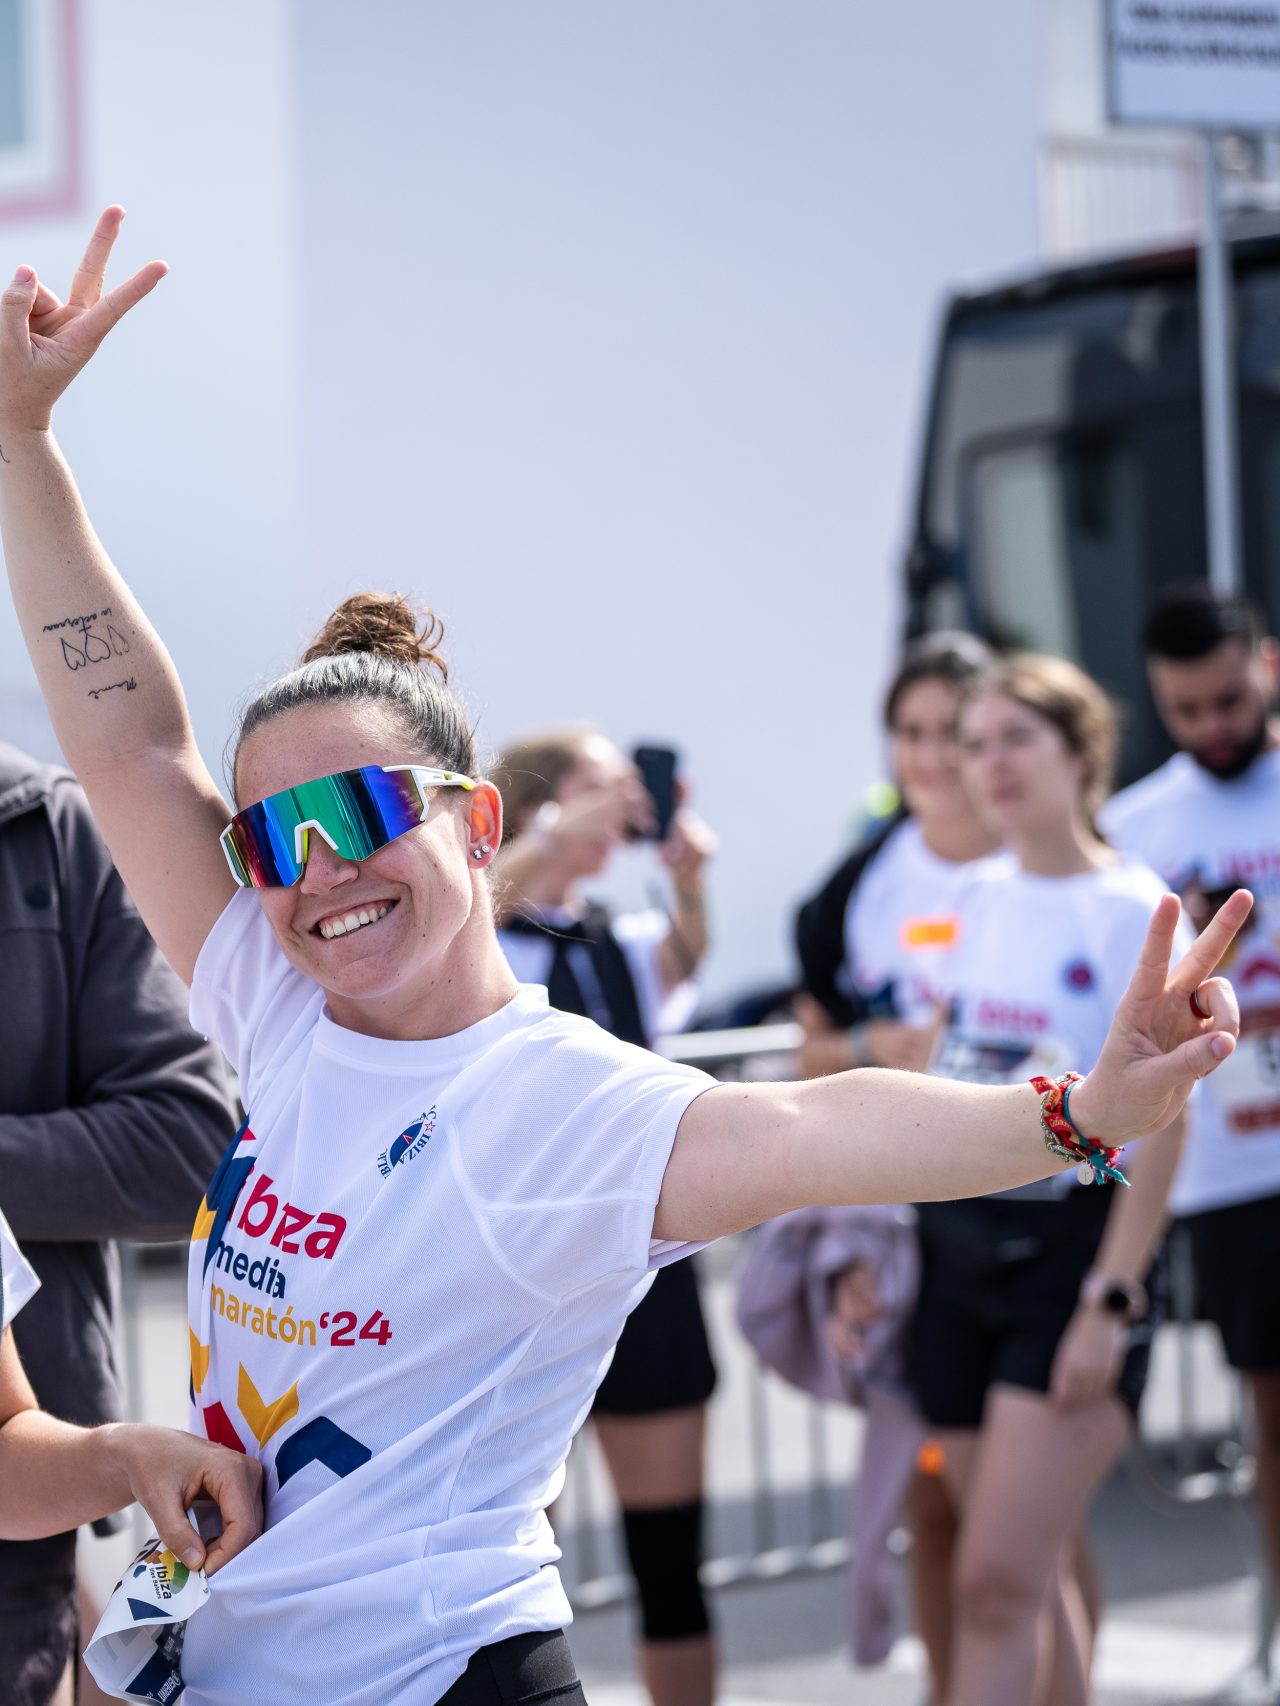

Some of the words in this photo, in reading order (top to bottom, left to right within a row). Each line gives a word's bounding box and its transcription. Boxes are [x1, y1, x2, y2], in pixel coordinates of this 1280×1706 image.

[397, 1133, 431, 1165] IBIZA
[216, 1239, 287, 1300] media
[156, 1566, 172, 1600] Ibiza
